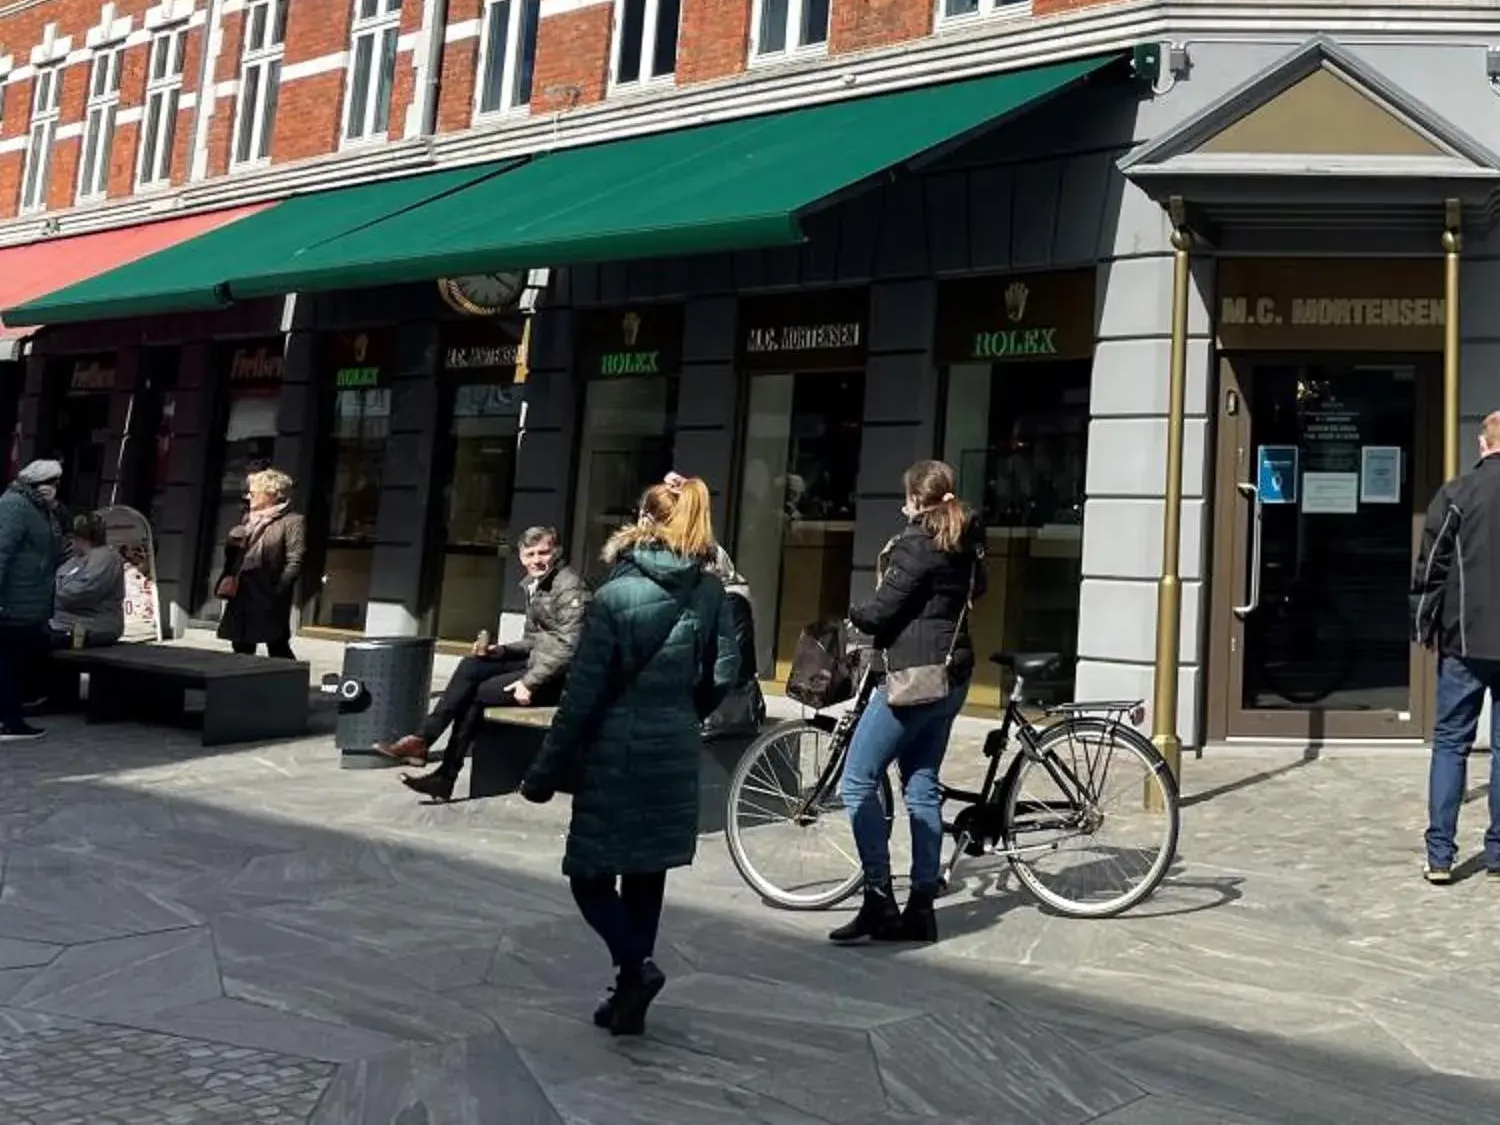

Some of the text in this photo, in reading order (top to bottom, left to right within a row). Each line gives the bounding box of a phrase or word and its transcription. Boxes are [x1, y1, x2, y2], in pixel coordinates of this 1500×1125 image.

[1221, 296, 1448, 326] M.C. MORTENSEN
[780, 322, 860, 351] MORTENSEN
[976, 326, 1058, 357] ROLEX
[601, 351, 659, 375] ROLEX
